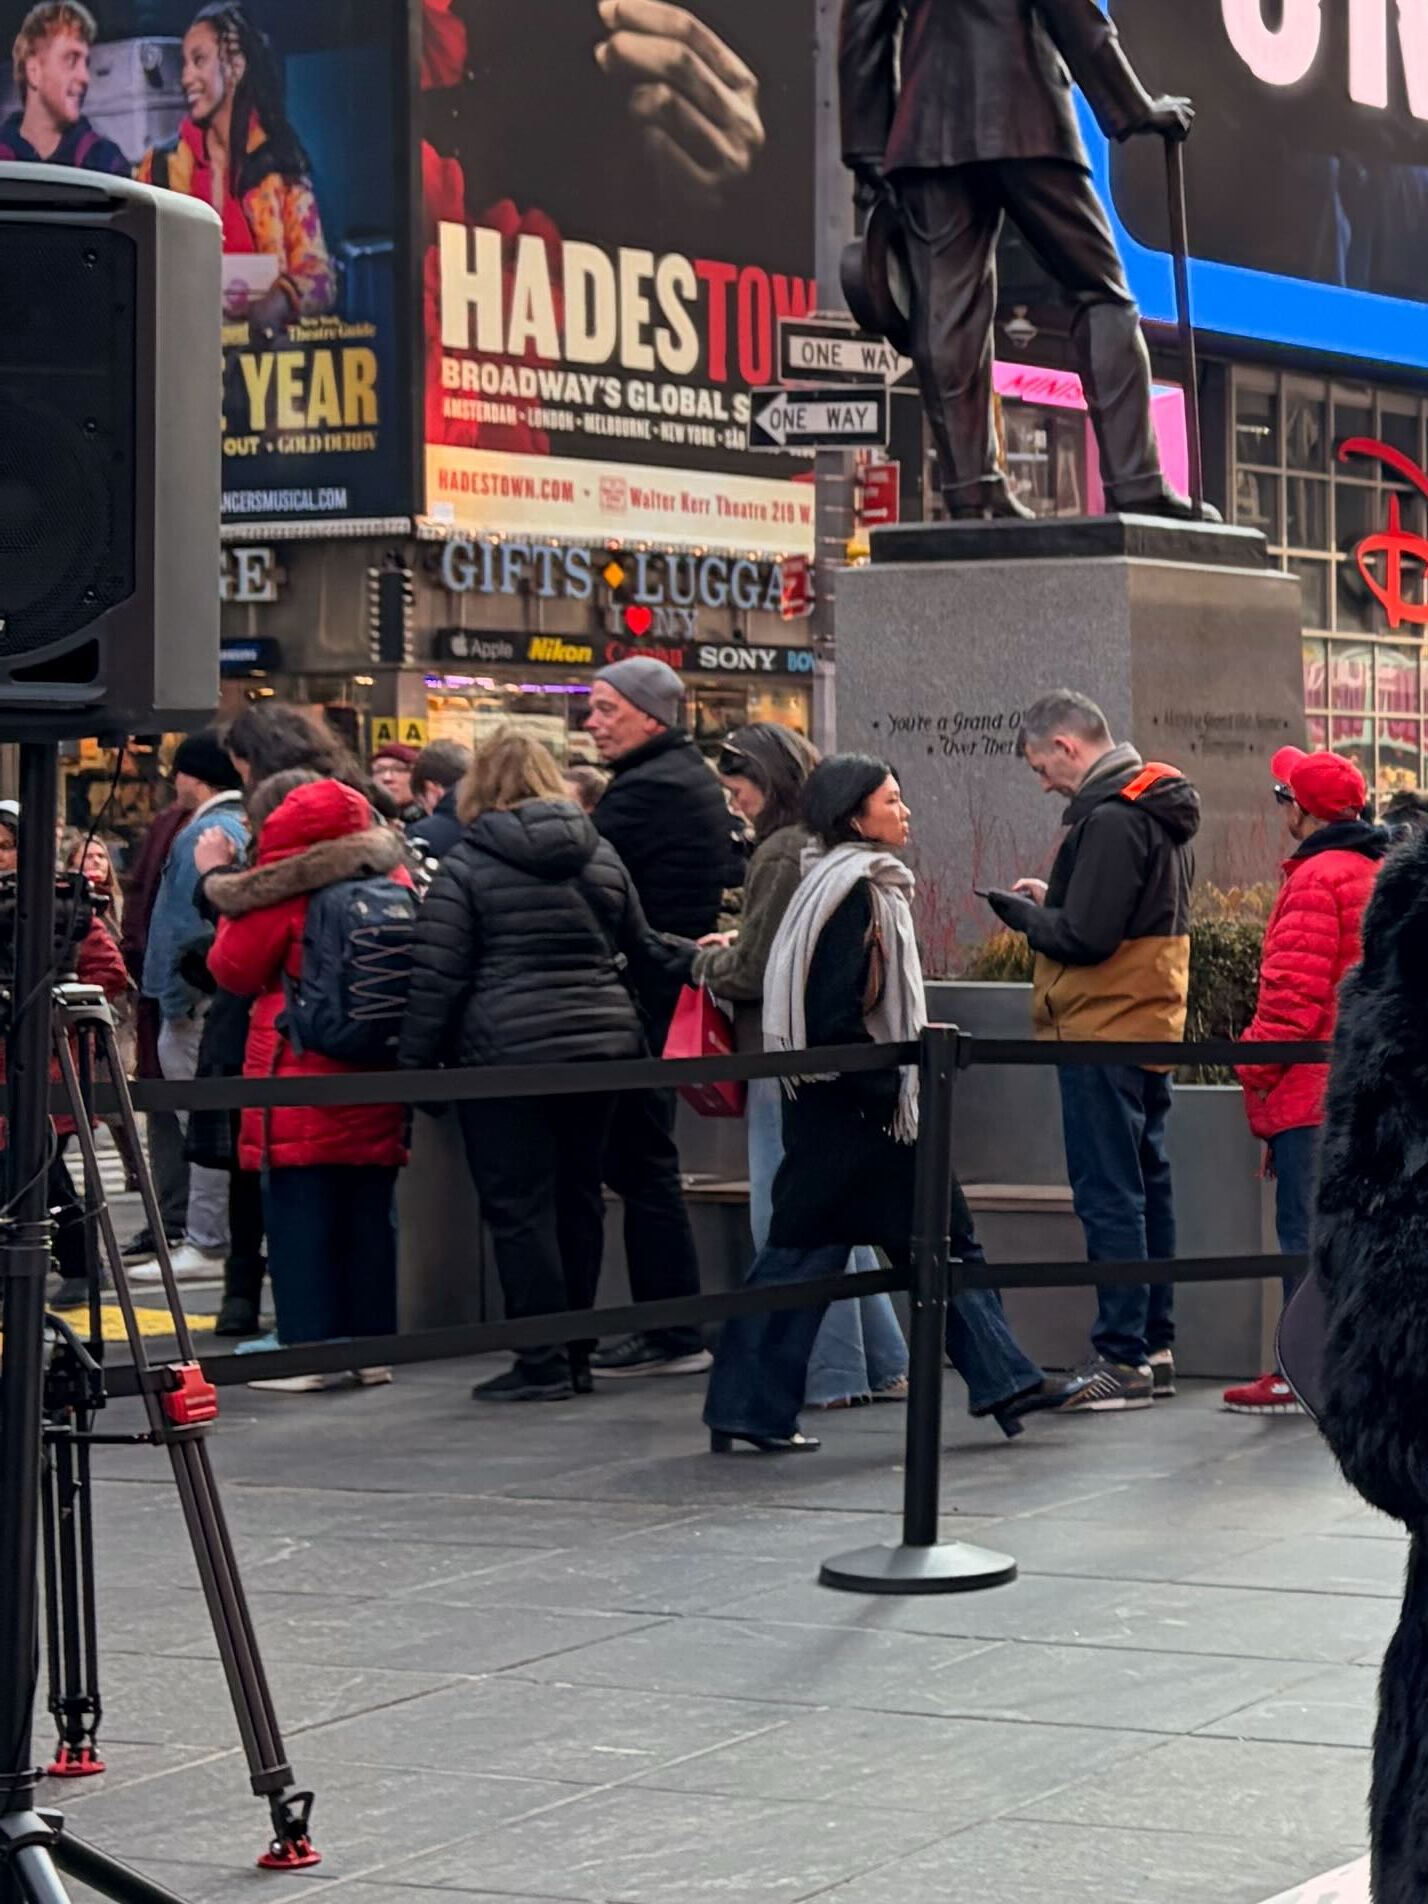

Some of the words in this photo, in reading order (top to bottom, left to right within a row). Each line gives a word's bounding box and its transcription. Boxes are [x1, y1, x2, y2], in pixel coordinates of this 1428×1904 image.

[801, 341, 843, 367] ONE
[861, 346, 901, 372] WAY
[239, 347, 378, 432] YEAR
[441, 356, 622, 410] BROADWAY'S
[627, 378, 729, 423] GLOBAL
[443, 397, 518, 427] AMSTERDAM
[527, 407, 575, 432] LONDON
[583, 412, 651, 441] MELBOURNE
[660, 420, 685, 444] NEW
[686, 422, 717, 448] YORK
[769, 406, 808, 430] ONE
[826, 405, 869, 429] WAY
[223, 435, 261, 457] OUT
[277, 433, 322, 454] GOLD
[438, 466, 575, 503] HADESTOWN.COM
[629, 486, 676, 512] Walter
[680, 490, 711, 515] Kerr
[715, 493, 768, 521] Theatre
[441, 539, 595, 600] GIFTS
[633, 552, 814, 612] LUGGA
[653, 605, 699, 640] NY
[470, 637, 514, 660] Apple
[528, 635, 594, 663] Nikon
[699, 645, 778, 672] SONY
[377, 722, 392, 740] A
[405, 722, 421, 740] A
[936, 715, 948, 731] a
[982, 734, 1016, 756] Ther
